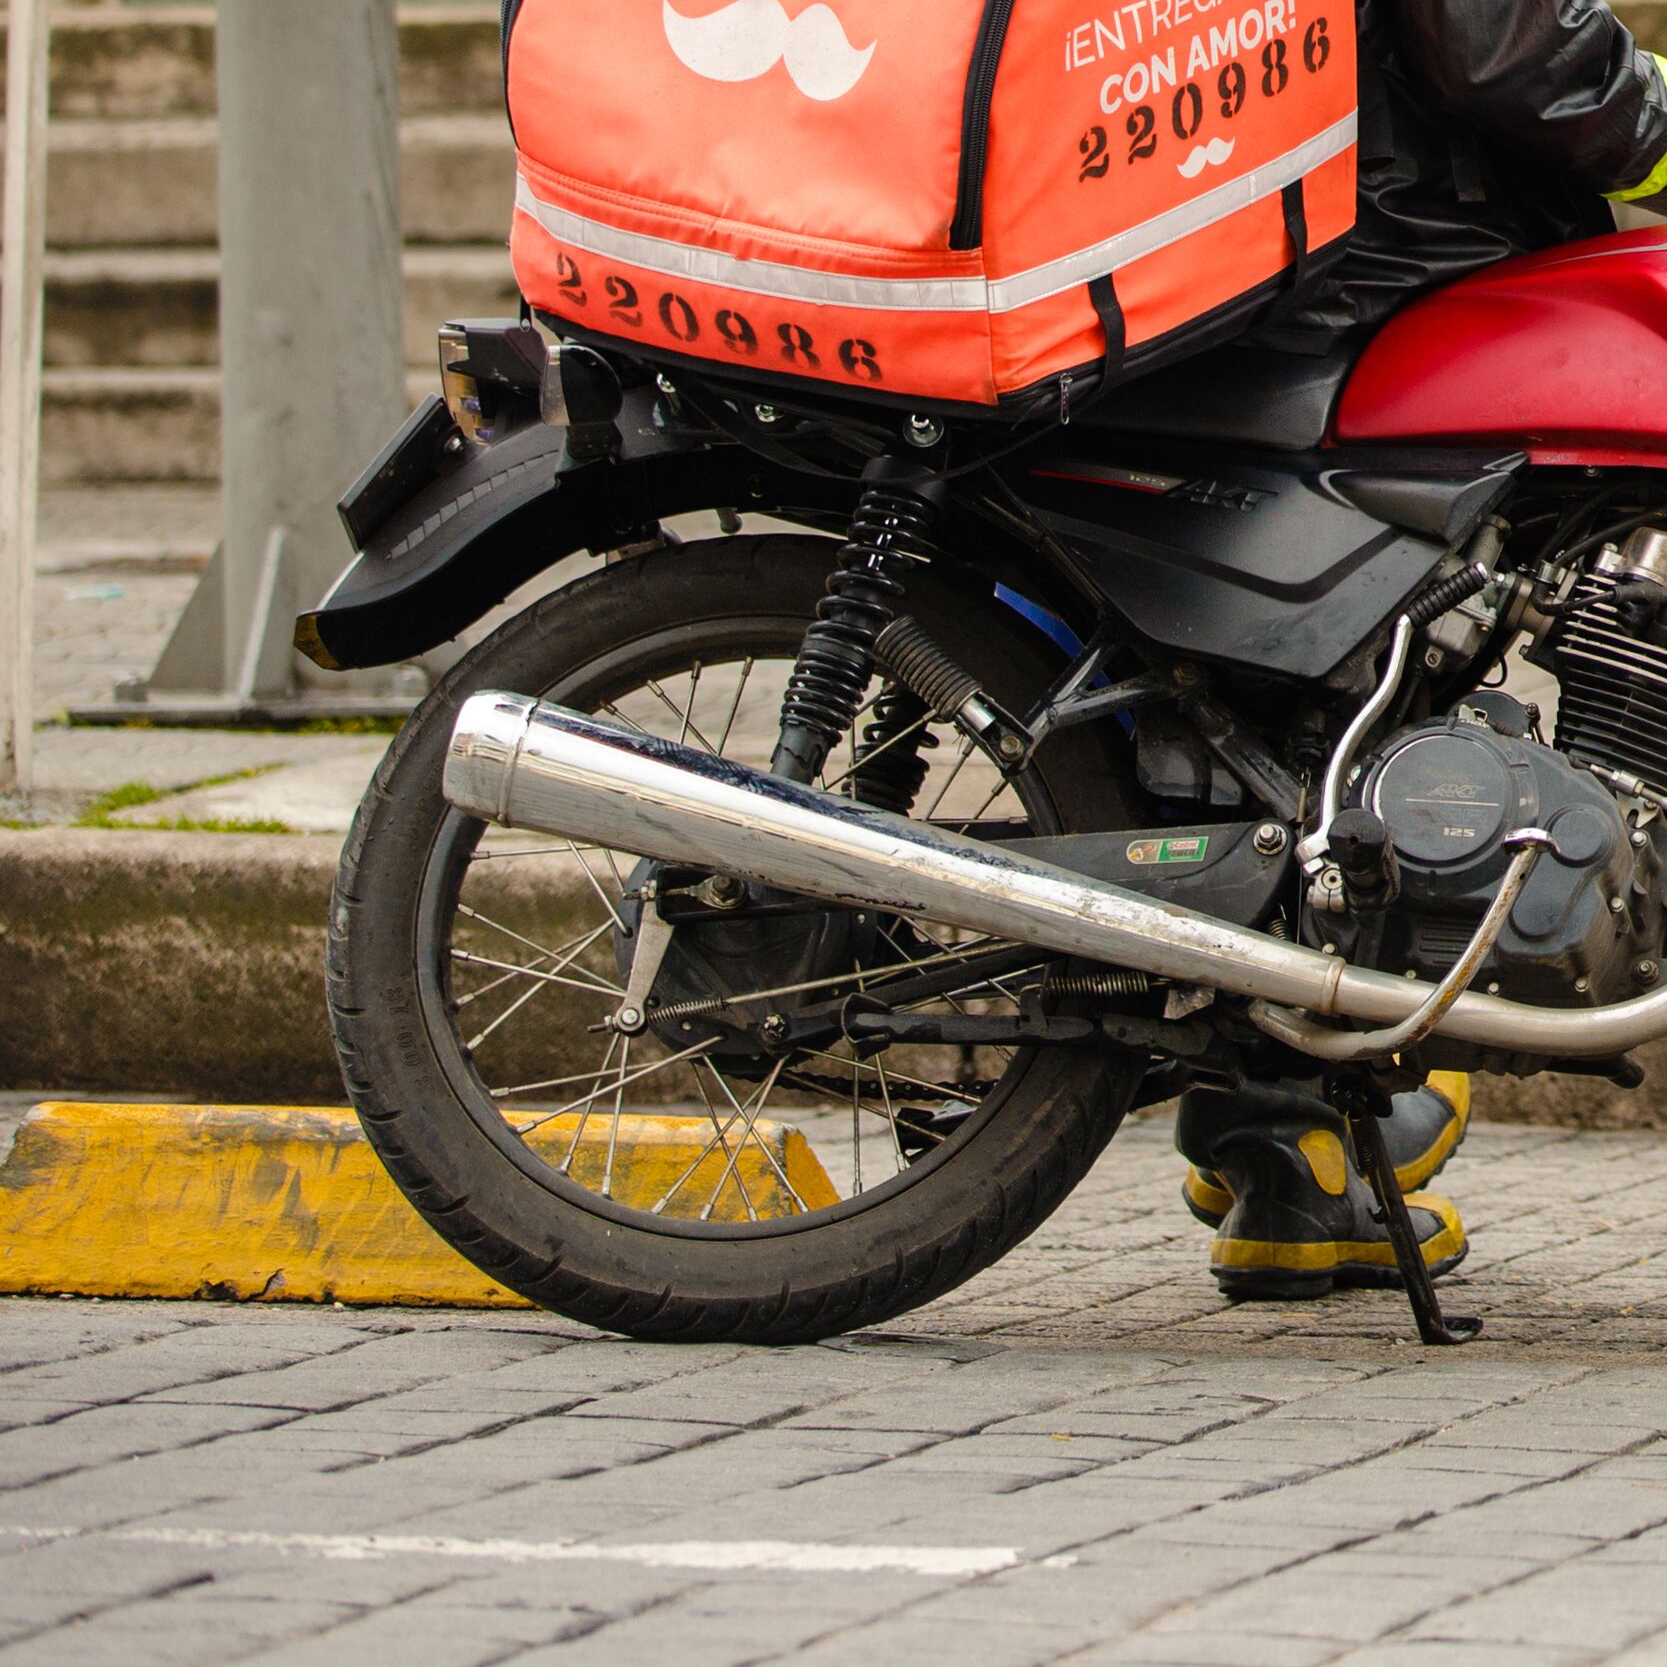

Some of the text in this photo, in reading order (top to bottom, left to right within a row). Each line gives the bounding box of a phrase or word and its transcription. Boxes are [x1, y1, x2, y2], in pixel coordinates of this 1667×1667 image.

[1078, 17, 1331, 184] 220986
[1100, 47, 1177, 115] CON
[556, 252, 883, 382] 220986
